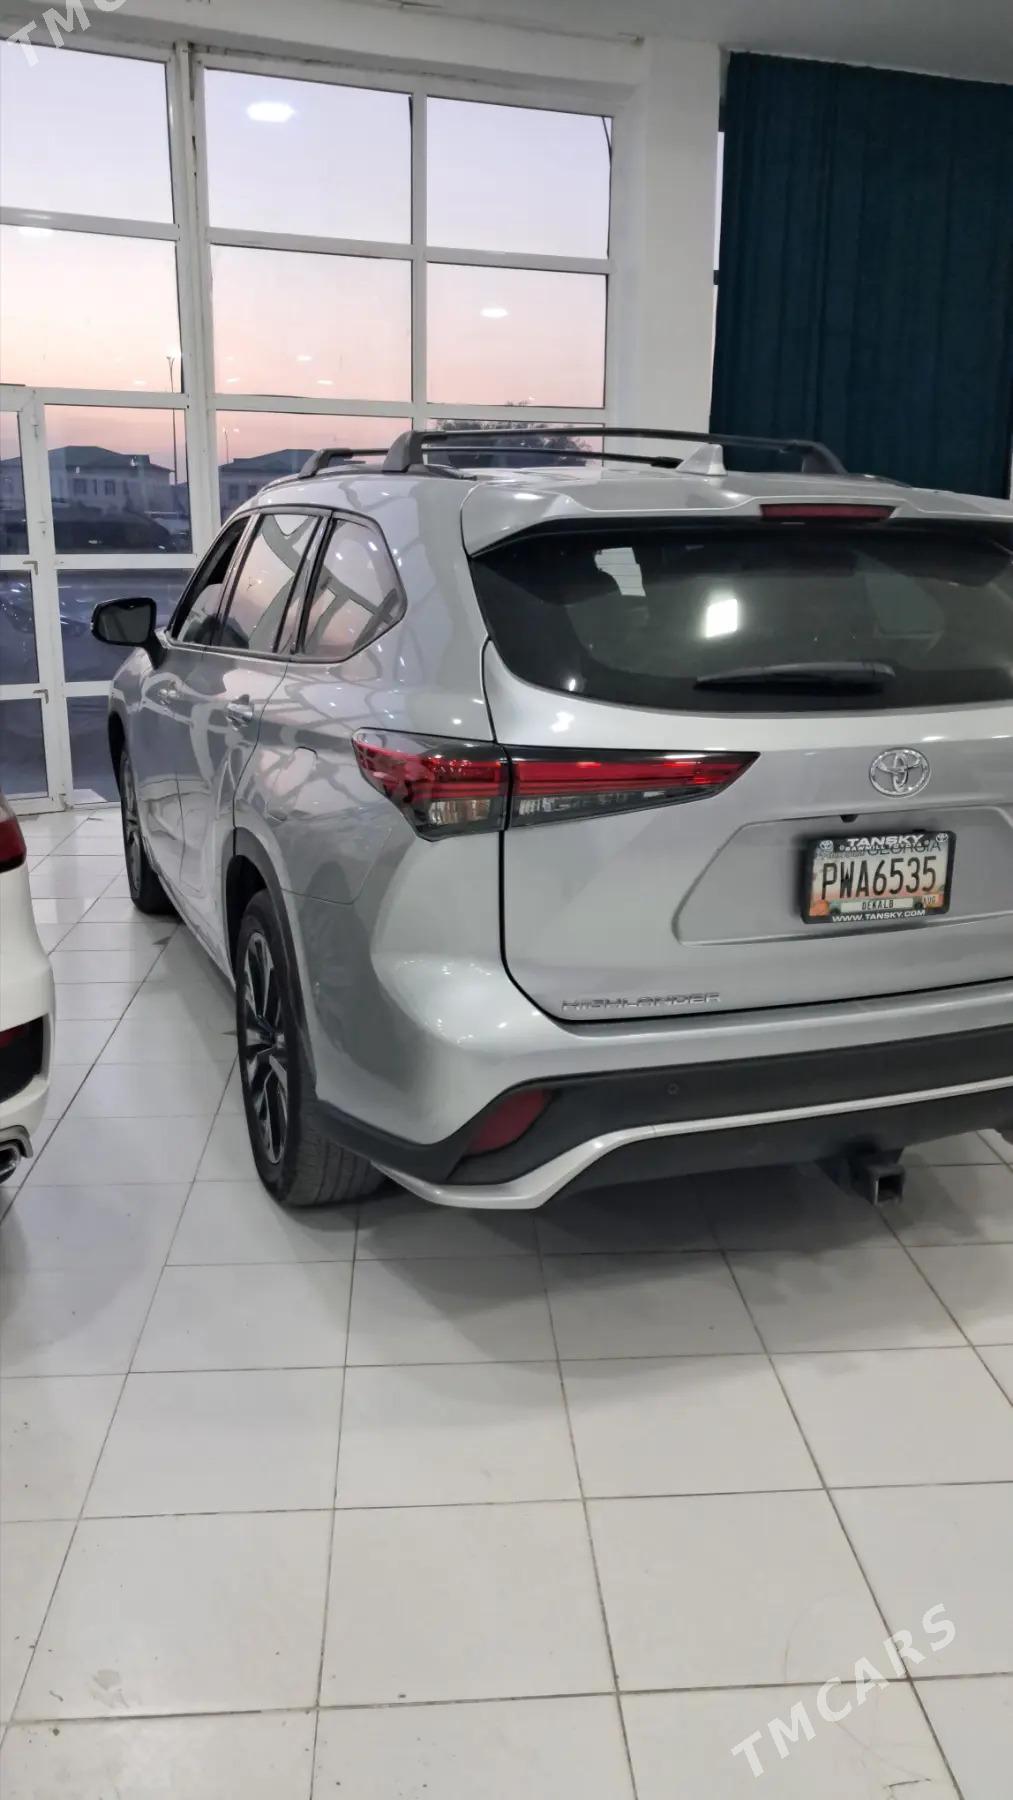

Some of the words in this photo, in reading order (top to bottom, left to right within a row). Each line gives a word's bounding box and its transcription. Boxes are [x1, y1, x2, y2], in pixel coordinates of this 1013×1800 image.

[846, 833, 924, 848] TANSKY
[821, 855, 937, 900] PWA6535
[861, 899, 894, 910] DEKALB
[832, 909, 926, 923] WWW.TANSKY.COM
[562, 991, 720, 1011] HIGHLANDER
